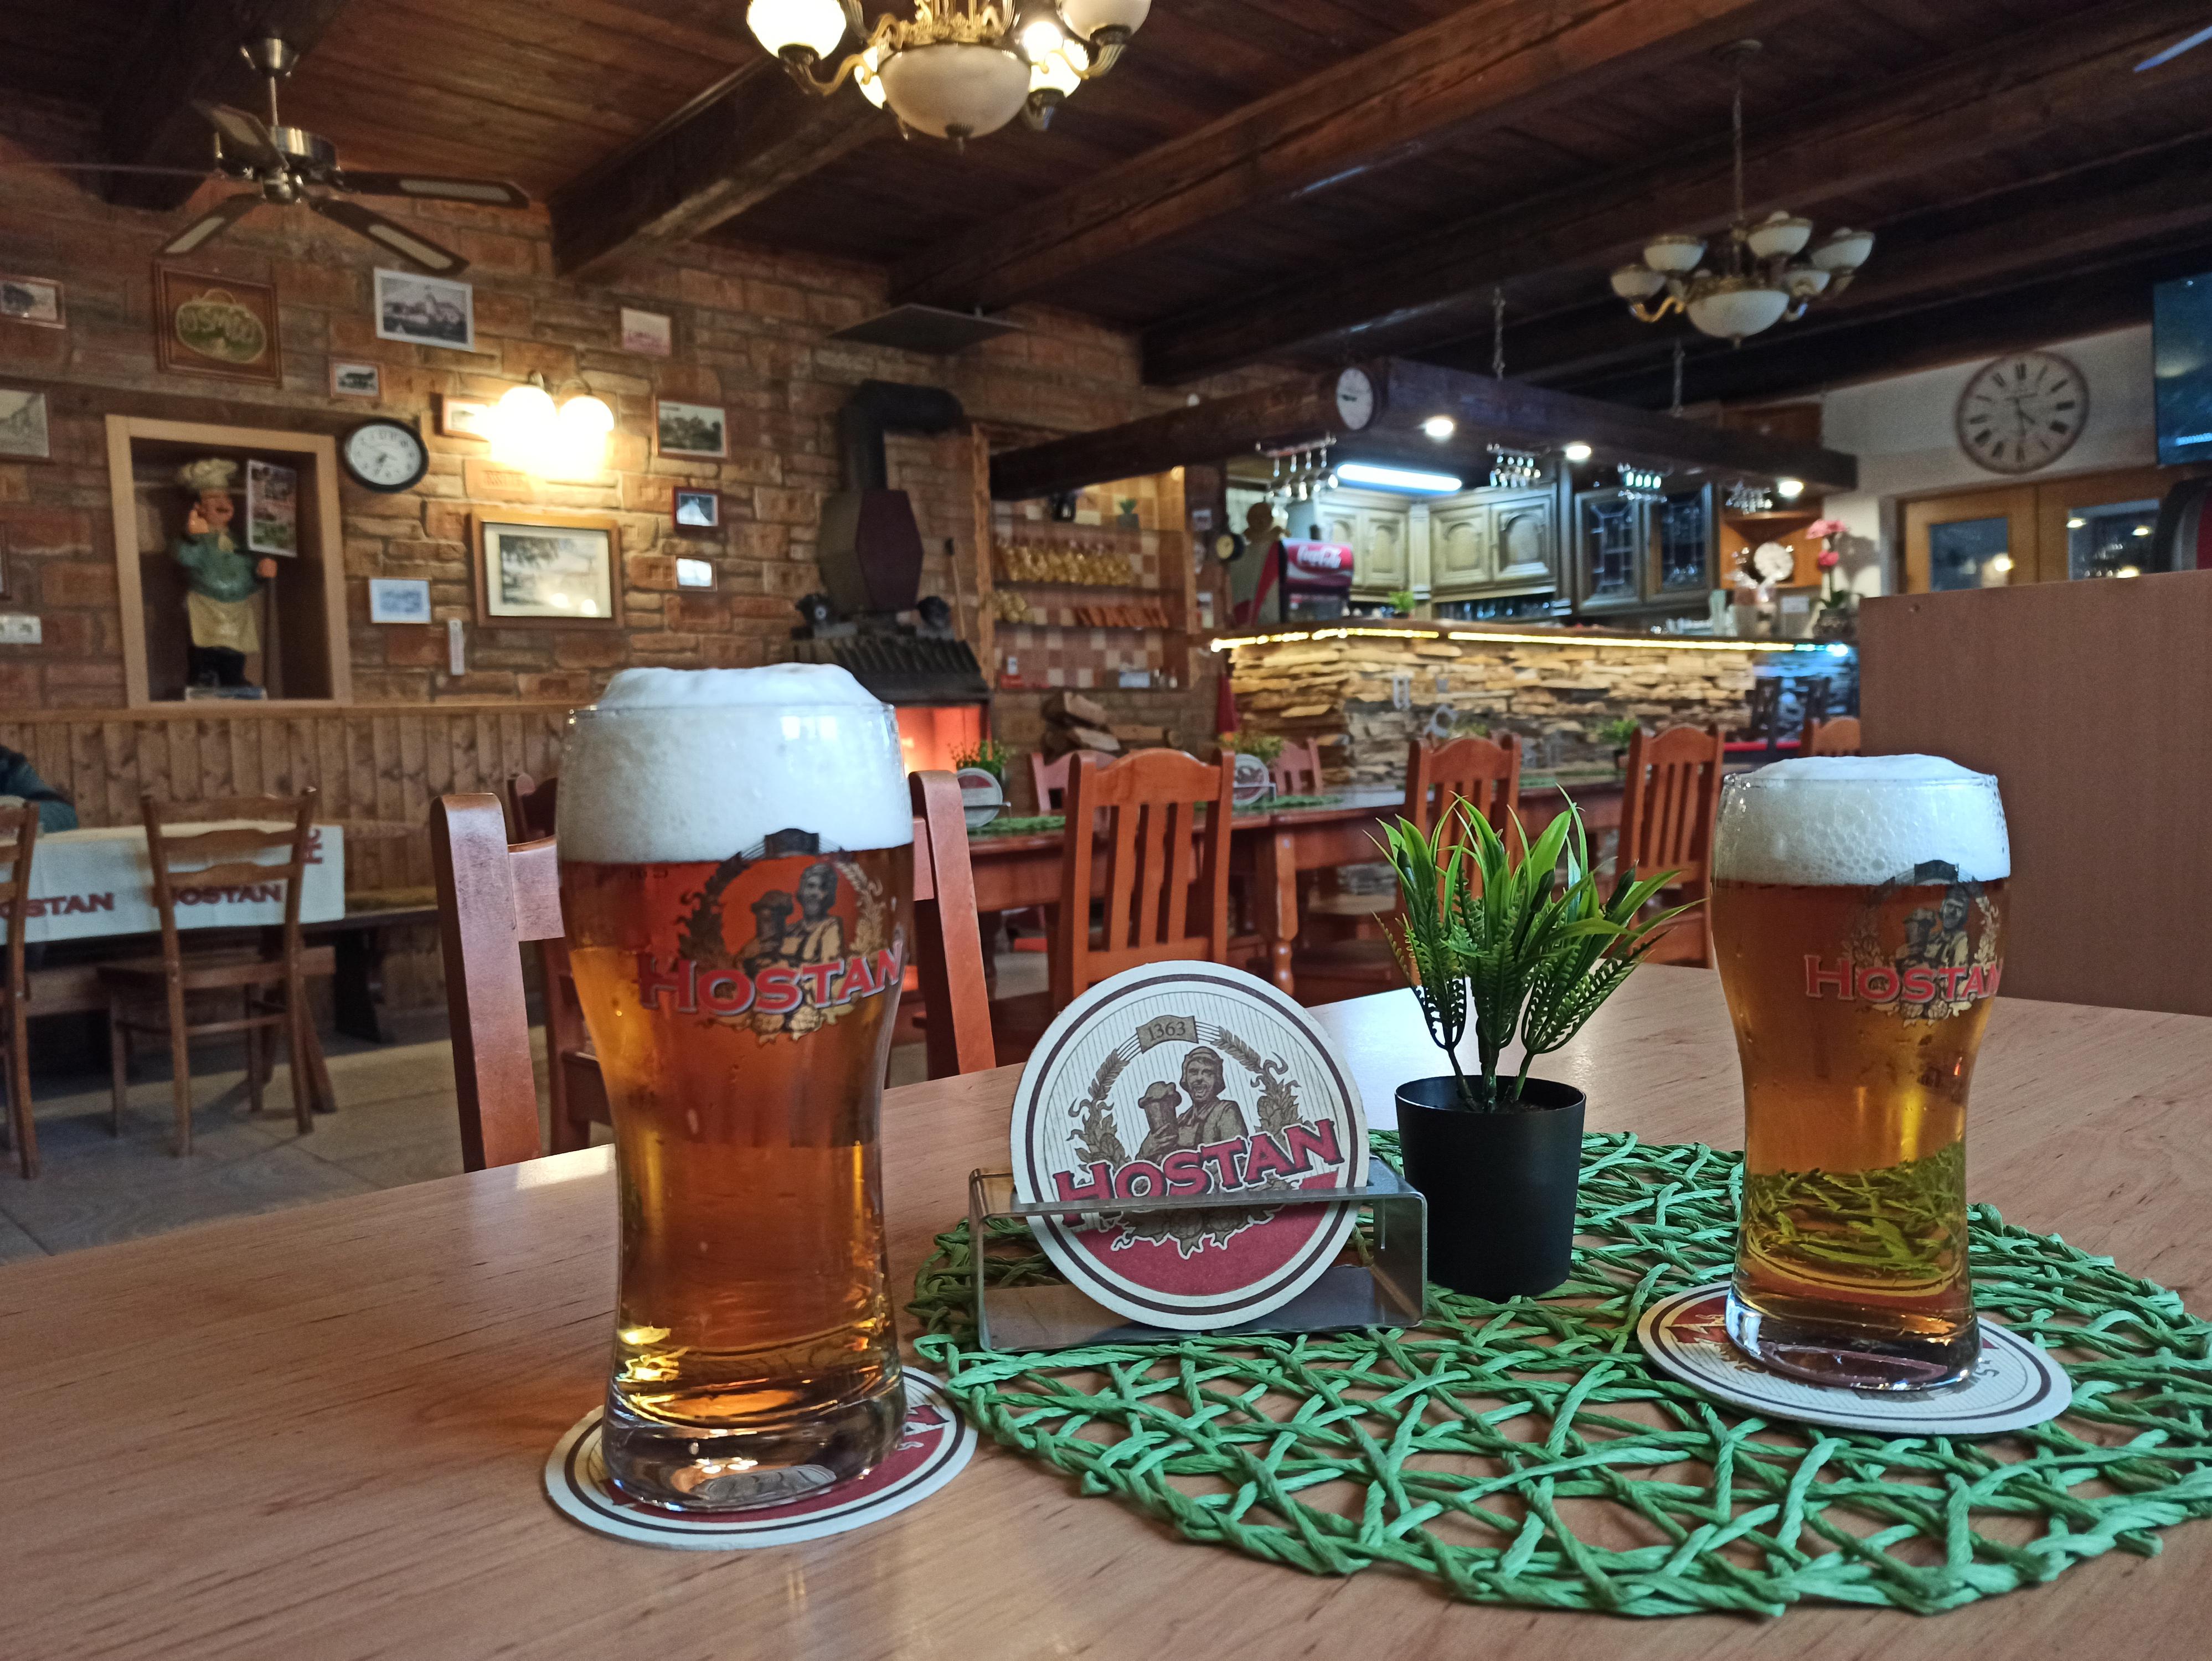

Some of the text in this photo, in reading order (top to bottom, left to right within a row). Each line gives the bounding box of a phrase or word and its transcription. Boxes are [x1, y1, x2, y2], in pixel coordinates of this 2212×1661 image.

[638, 939, 904, 1015] HOSTAN
[1804, 955, 2004, 1003] HOSTAN
[1147, 1022, 1186, 1042] 1363
[1053, 1118, 1344, 1228] HOSTAN
